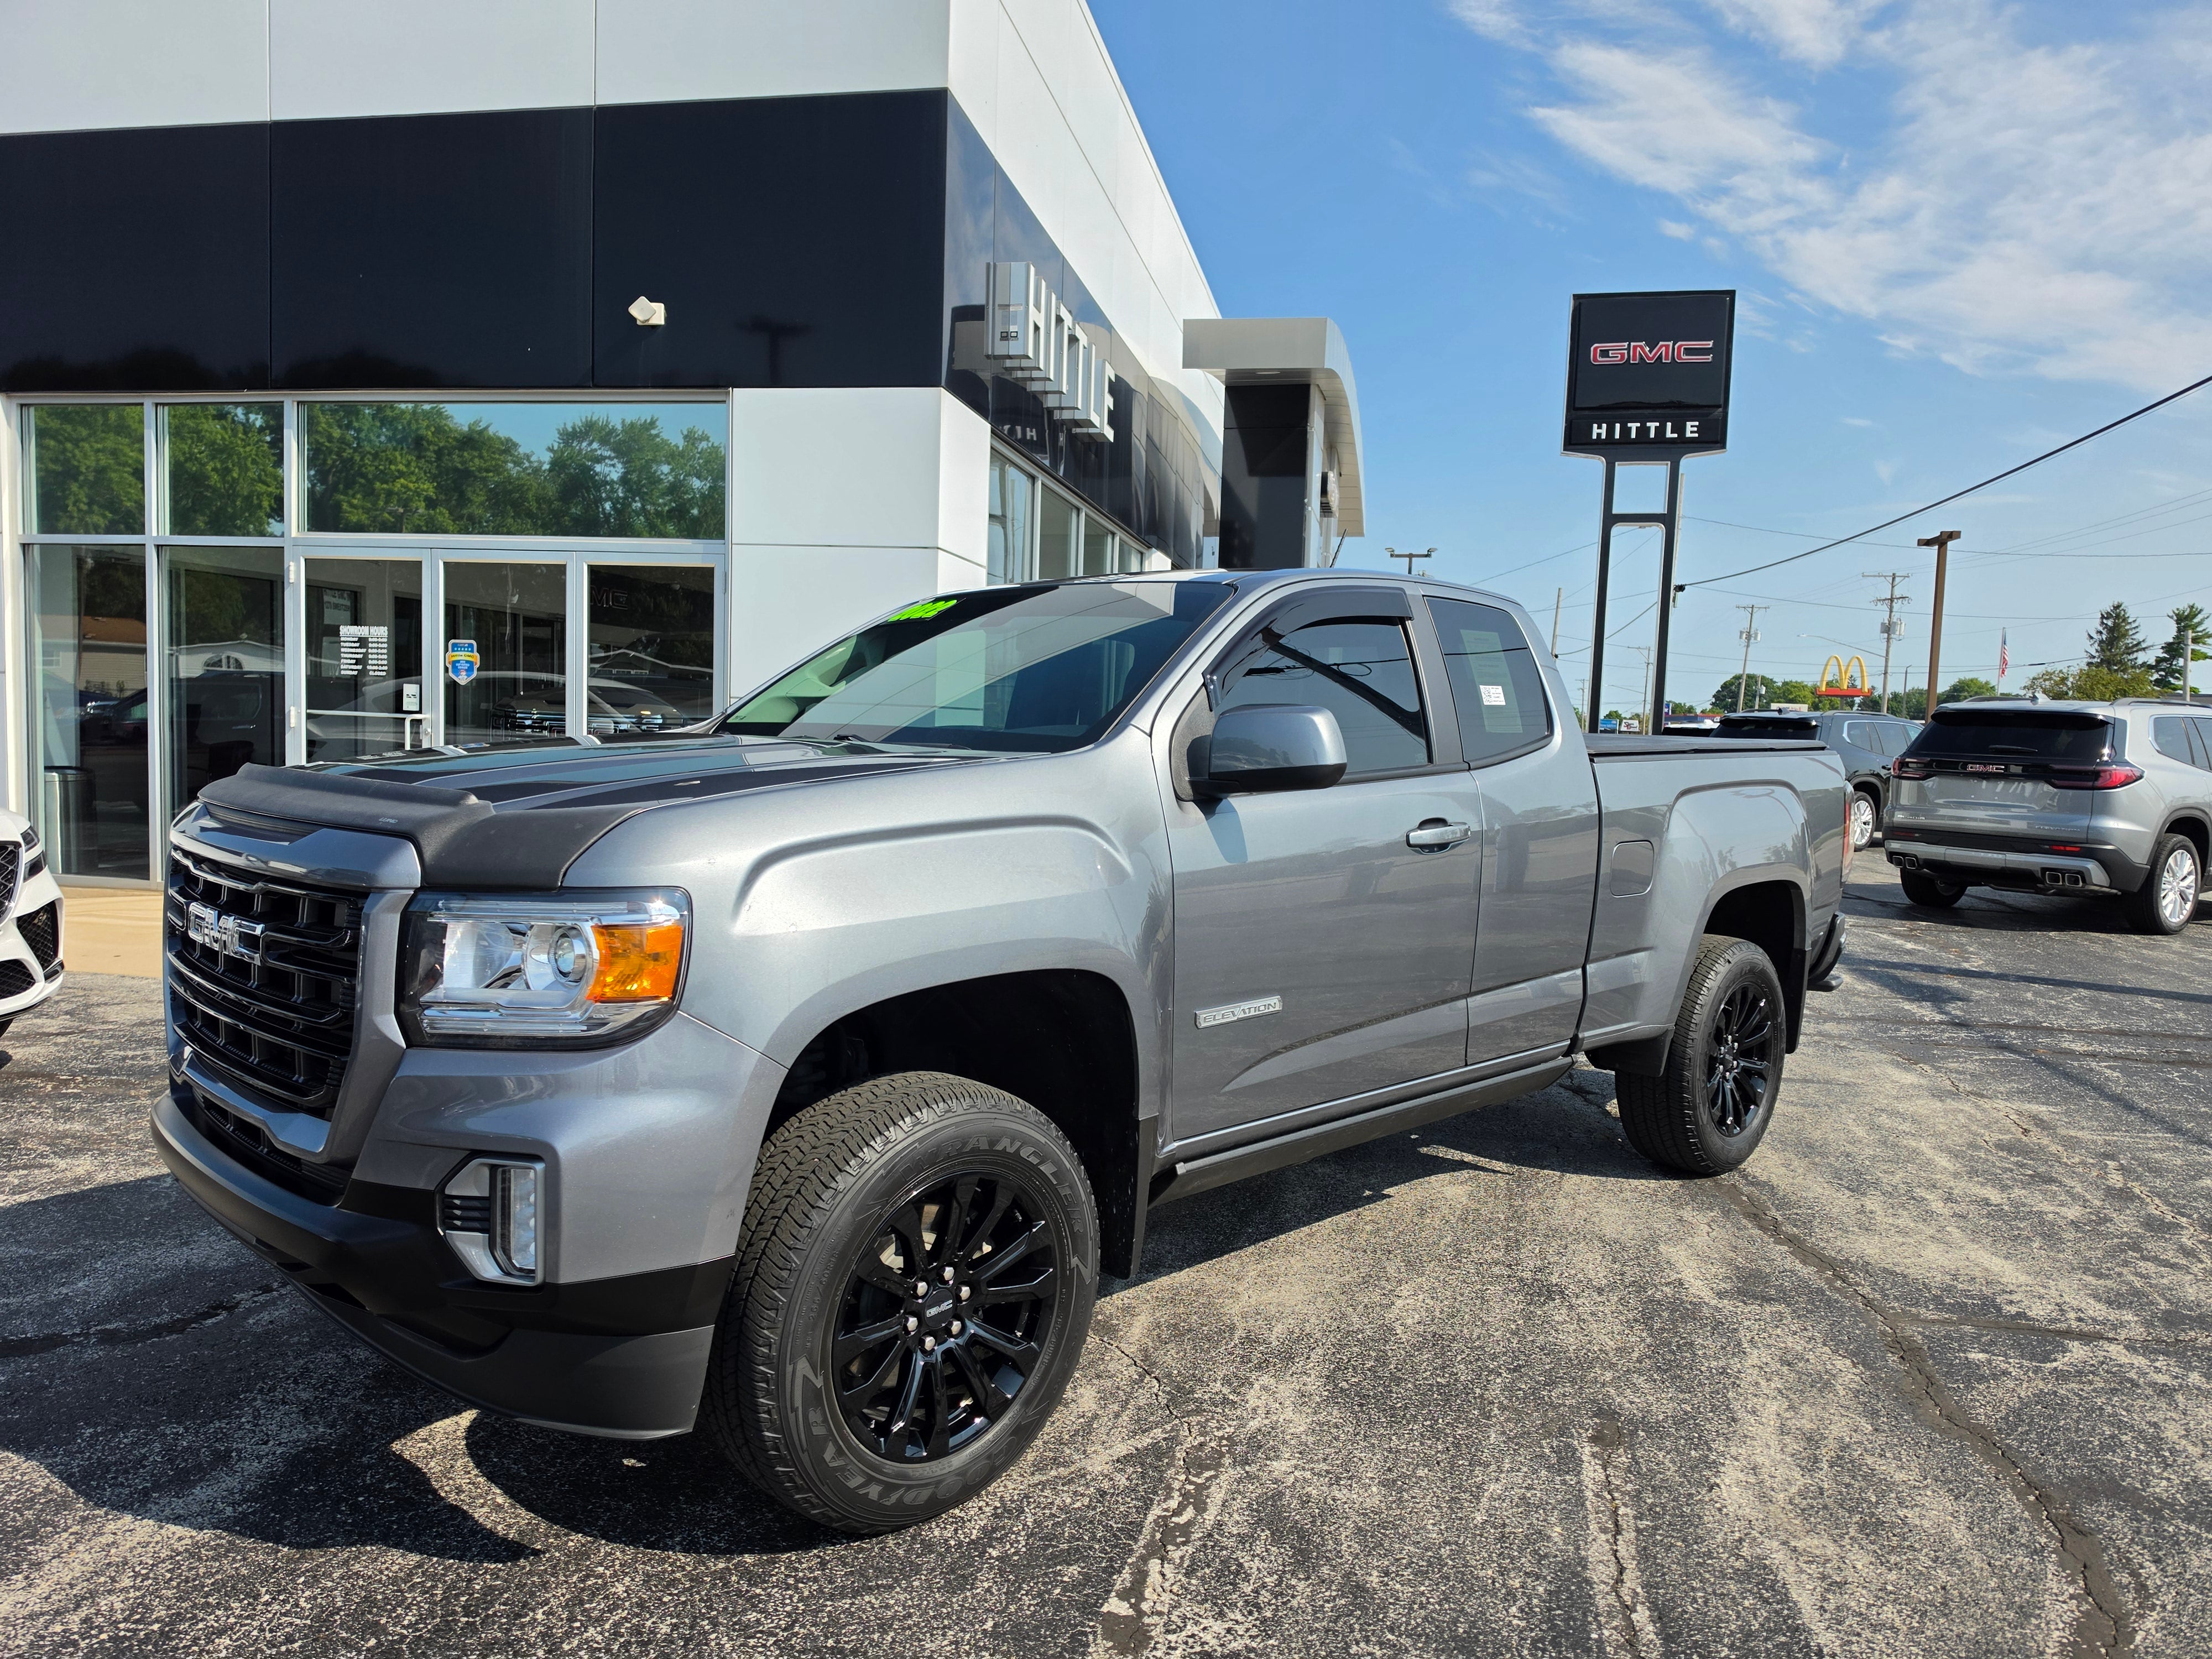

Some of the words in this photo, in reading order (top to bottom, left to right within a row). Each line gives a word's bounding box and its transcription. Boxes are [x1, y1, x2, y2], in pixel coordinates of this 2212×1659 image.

[1006, 262, 1115, 442] HITTLE
[1590, 341, 1714, 365] GMC
[1592, 421, 1699, 439] HITTLE
[589, 585, 628, 610] MC
[340, 625, 369, 635] SHOWROOM
[370, 626, 388, 636] HOURS
[1967, 764, 2005, 773] GMC
[188, 902, 265, 966] GMC
[1203, 1002, 1276, 1023] ELEVATION
[899, 1134, 1084, 1234] WRANGLER
[927, 1300, 953, 1317] GMC
